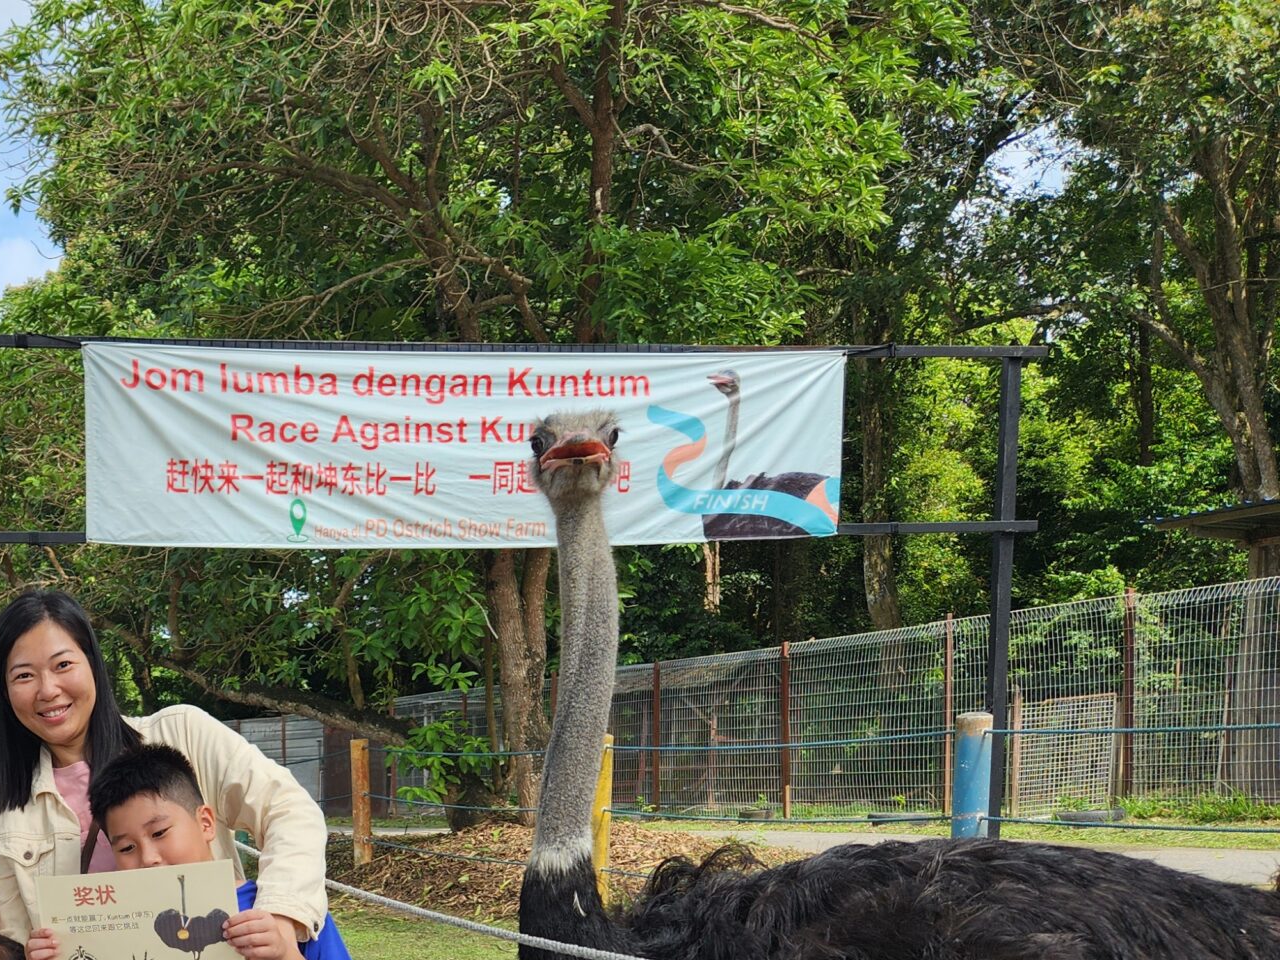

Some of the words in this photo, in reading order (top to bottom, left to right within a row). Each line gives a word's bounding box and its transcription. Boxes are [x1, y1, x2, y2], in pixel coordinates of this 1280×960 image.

[120, 359, 205, 392] Jom
[220, 362, 338, 396] lumba
[352, 366, 492, 405] dengan
[508, 367, 651, 398] Kuntum
[230, 414, 319, 444] Race
[332, 414, 467, 450] Against
[166, 458, 437, 497] 赶快来一起和坤东比一比
[692, 494, 769, 512] FINISH
[365, 518, 387, 538] PD
[392, 516, 452, 538] Ostrich
[458, 517, 501, 540] Show
[506, 517, 546, 537] Farm
[72, 883, 117, 906] 奖状
